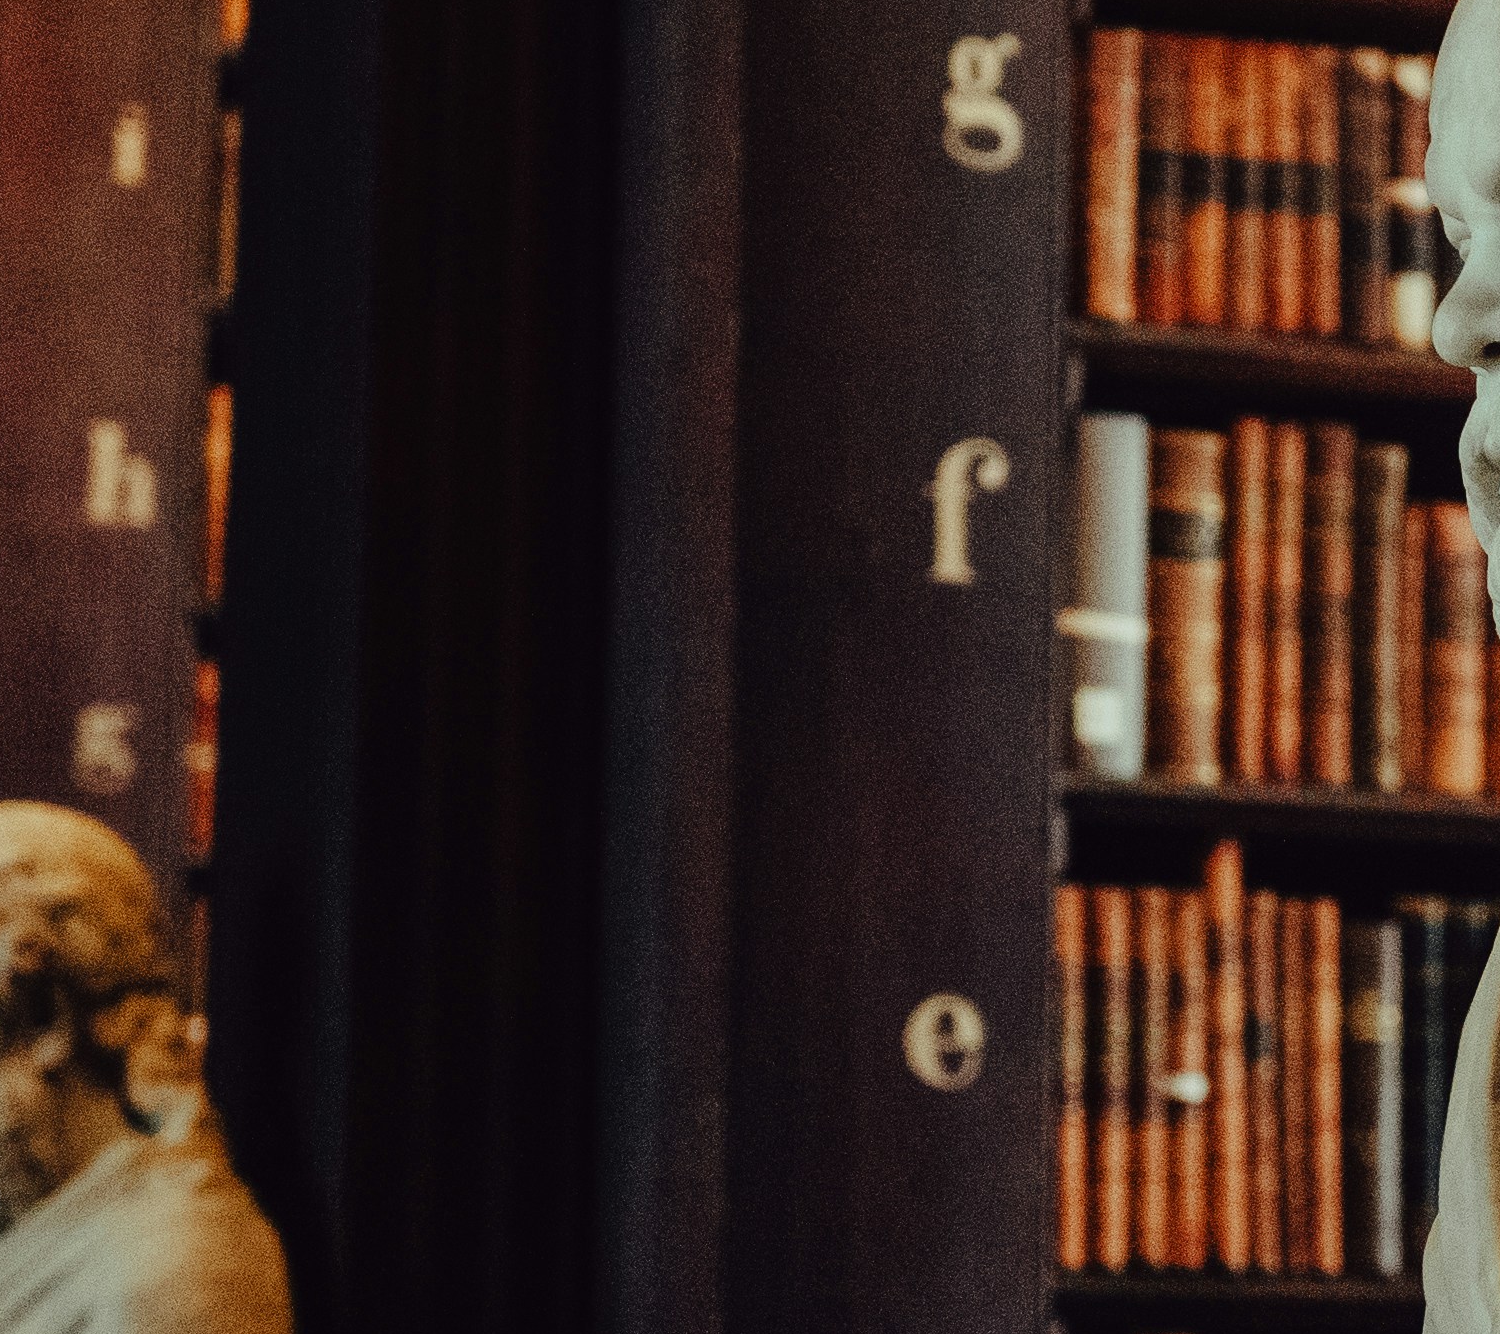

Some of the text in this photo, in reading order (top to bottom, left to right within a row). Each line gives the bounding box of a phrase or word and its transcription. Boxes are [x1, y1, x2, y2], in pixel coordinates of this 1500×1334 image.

[942, 31, 1025, 173] g
[85, 419, 158, 529] h
[925, 435, 1012, 586] f
[903, 992, 988, 1092] e
